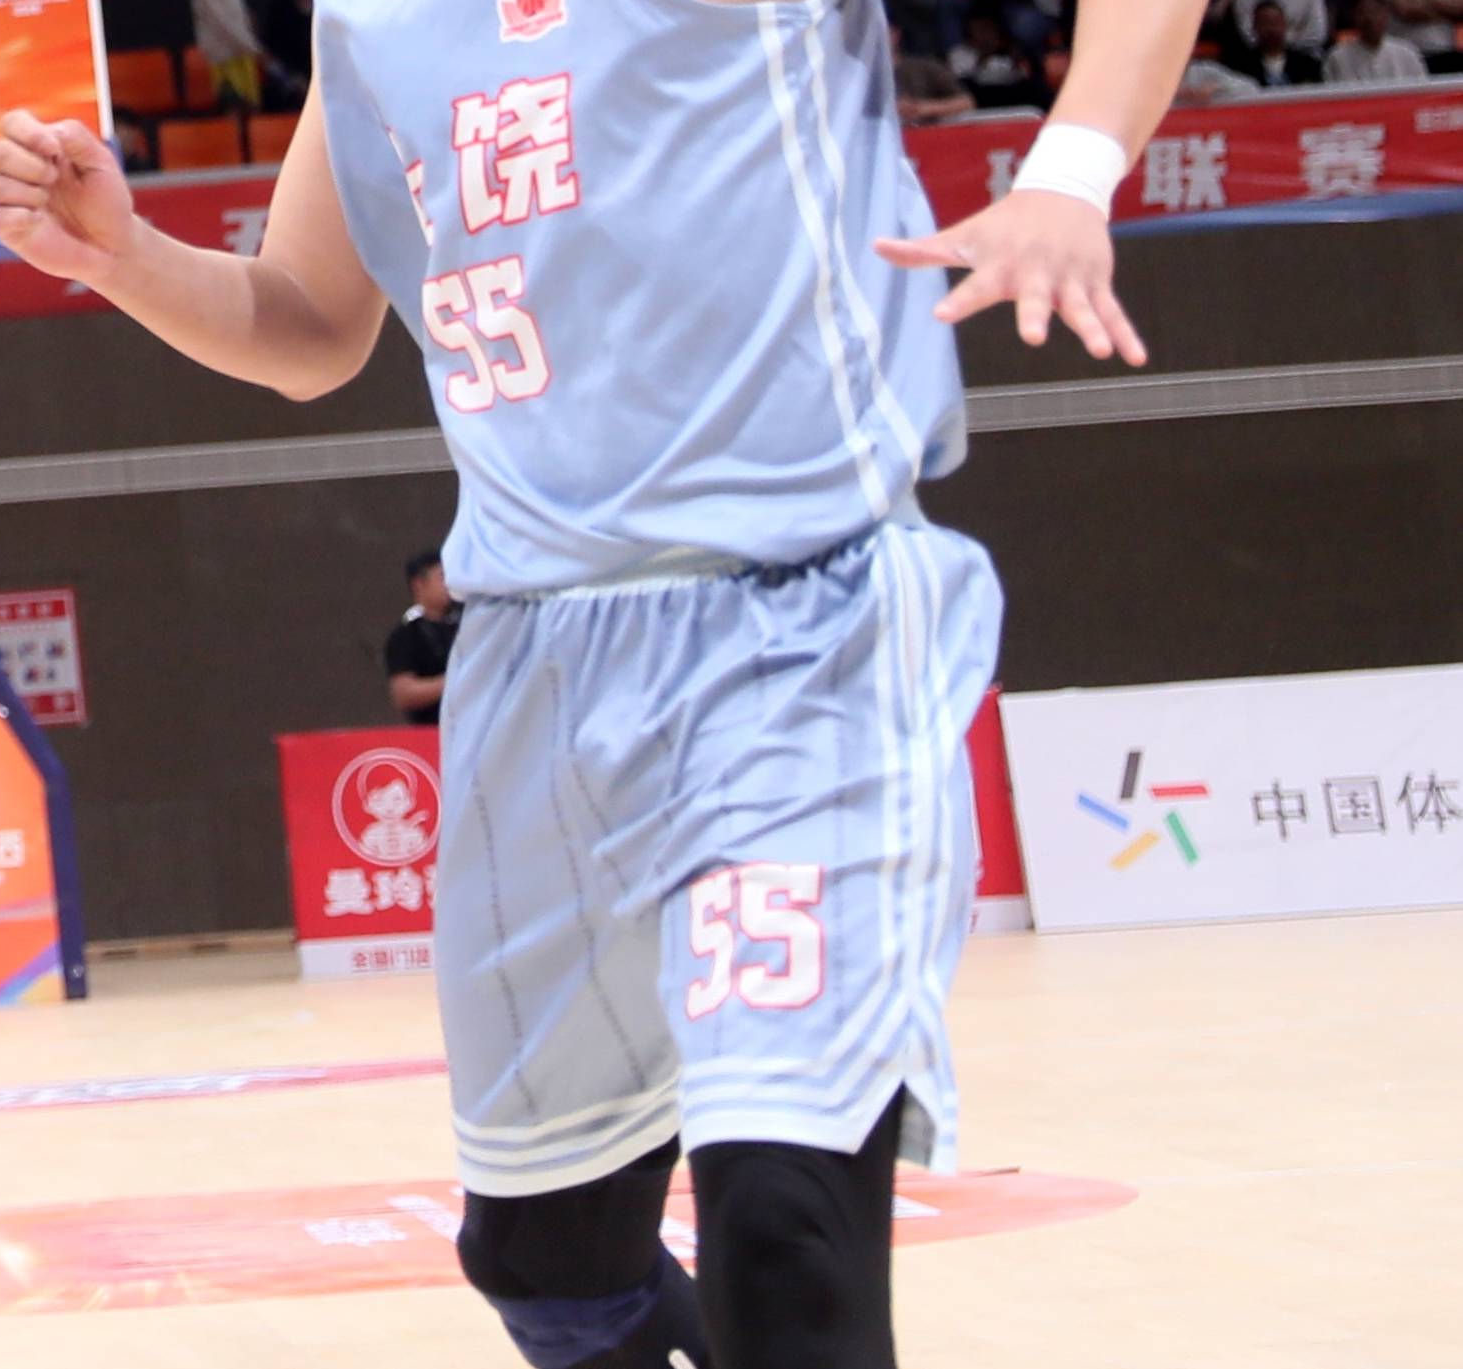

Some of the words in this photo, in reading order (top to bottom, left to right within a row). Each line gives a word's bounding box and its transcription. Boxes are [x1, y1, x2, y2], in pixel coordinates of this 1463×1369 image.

[421, 253, 553, 414] 55
[1251, 769, 1463, 840] 中国体
[684, 860, 827, 1020] 55
